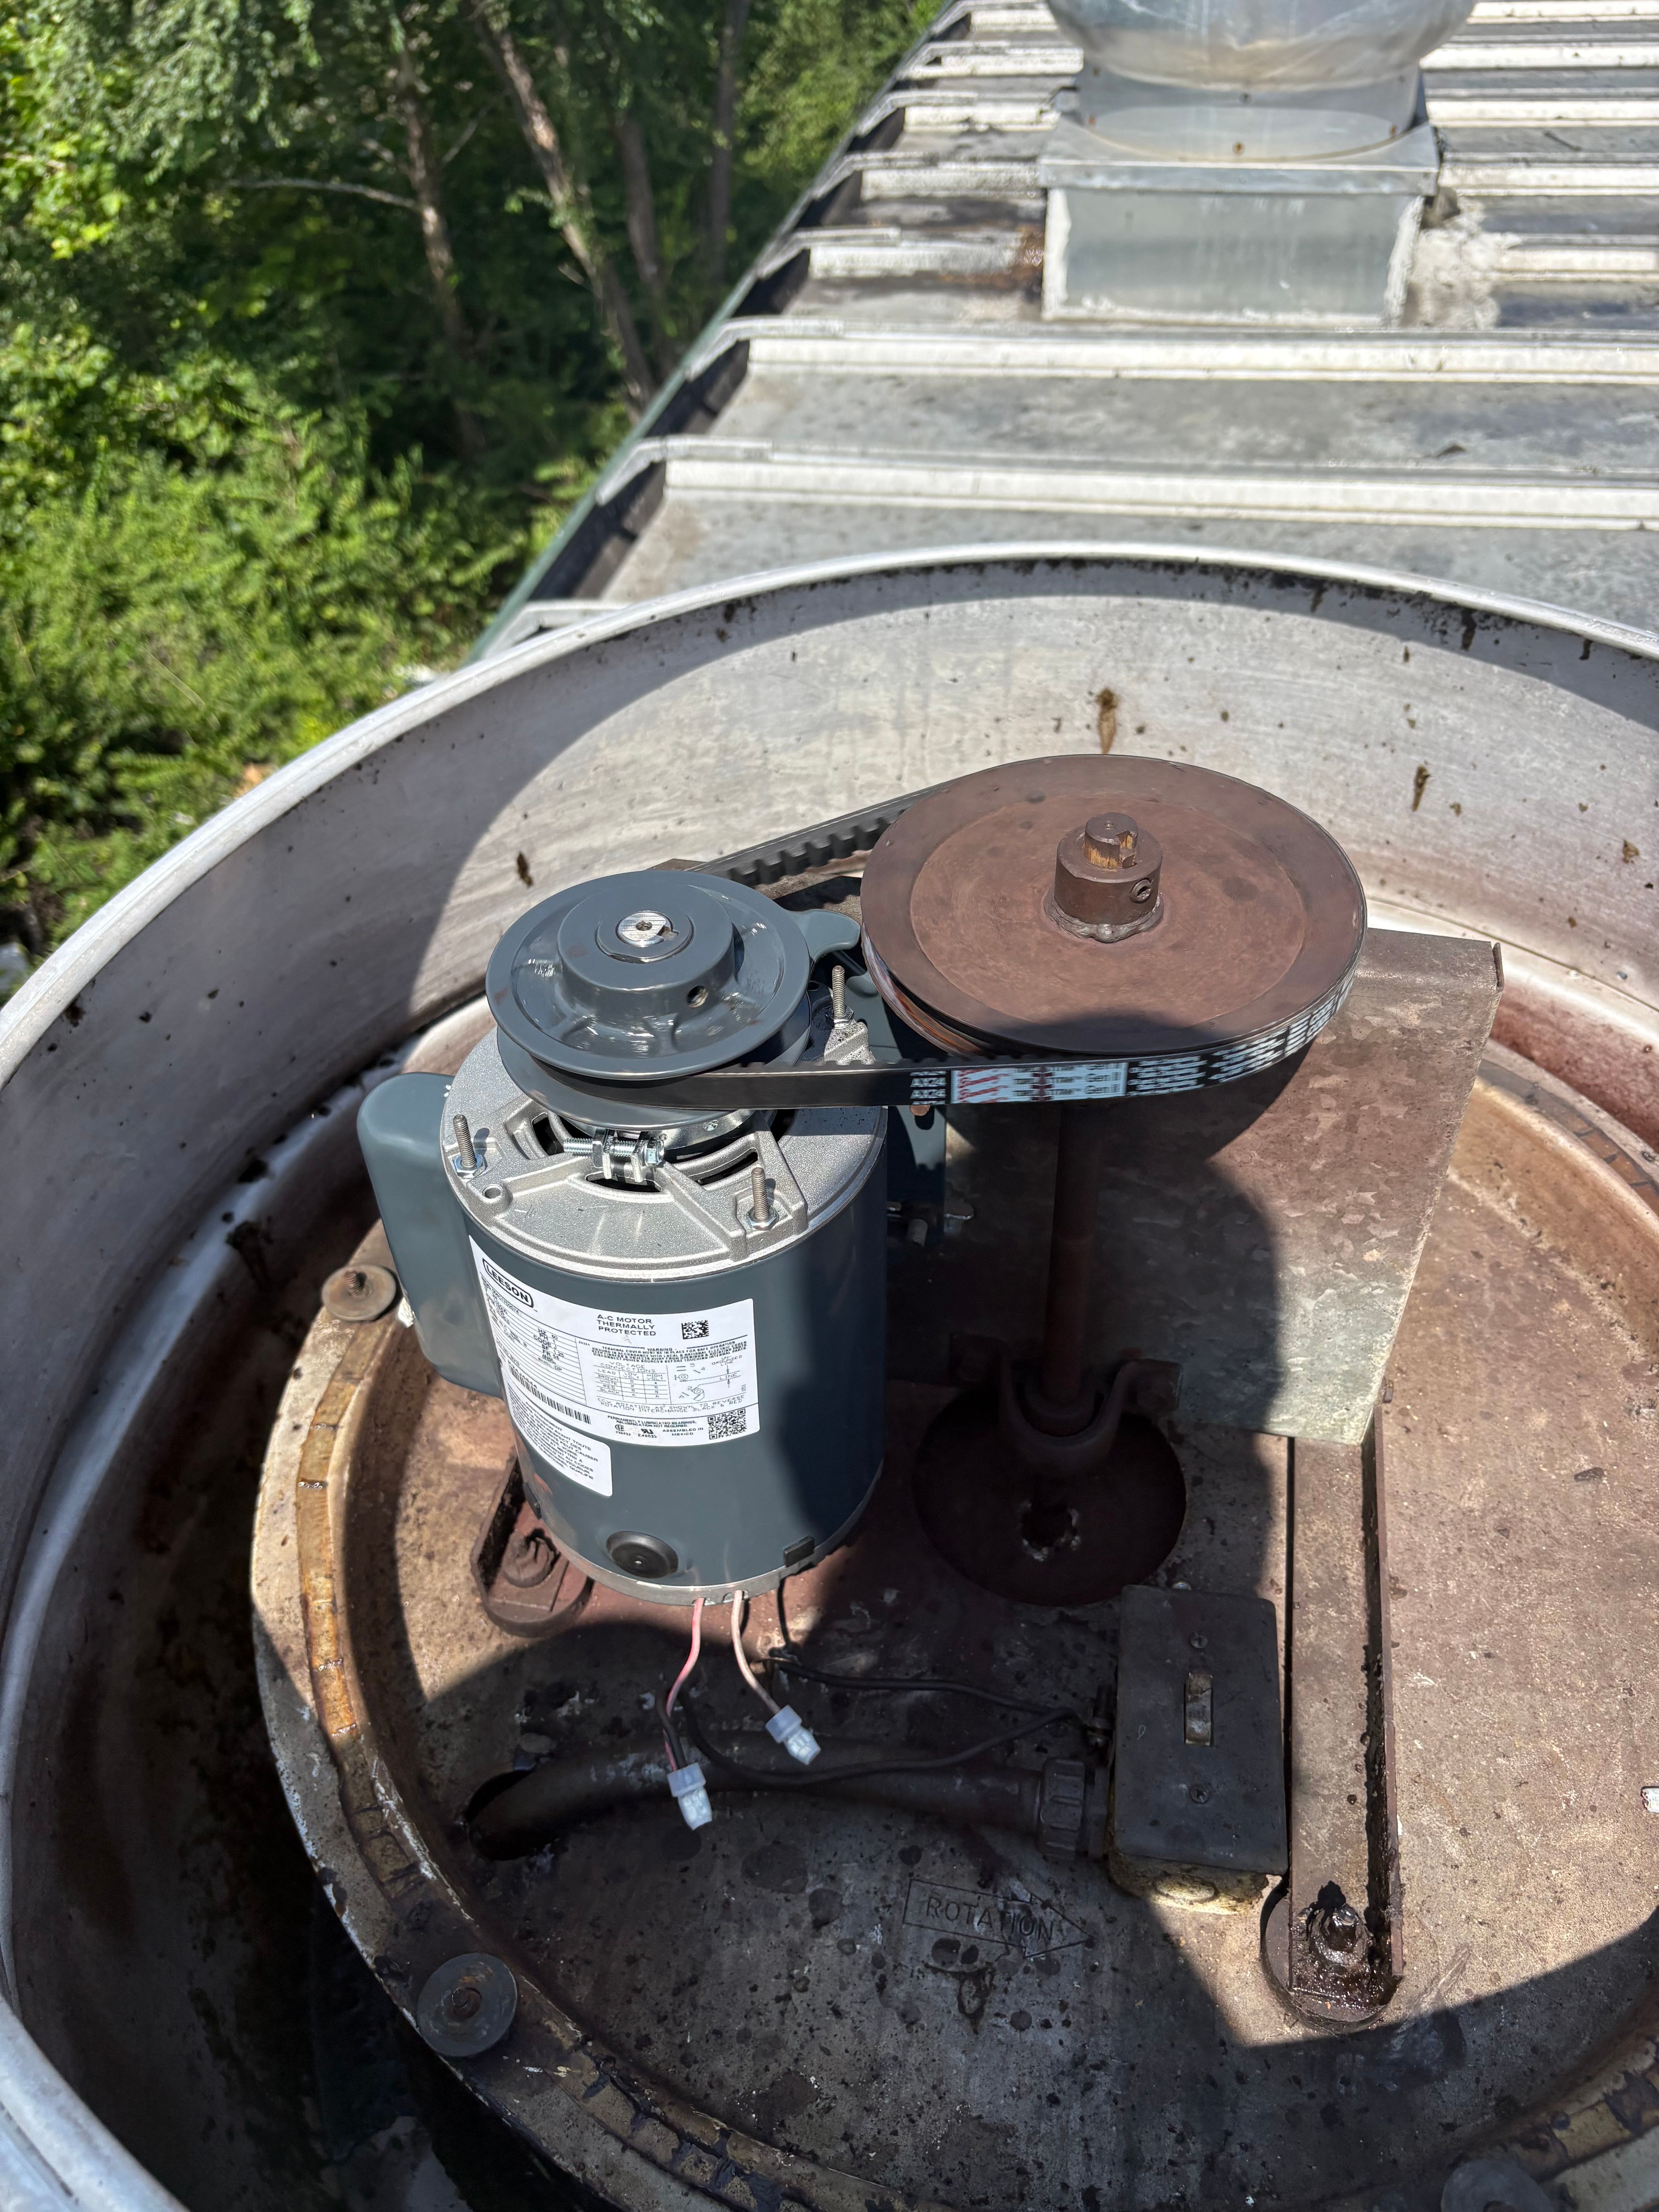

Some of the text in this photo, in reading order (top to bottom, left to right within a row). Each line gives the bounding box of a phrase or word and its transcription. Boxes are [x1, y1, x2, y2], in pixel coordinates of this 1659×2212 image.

[486, 1264, 529, 1303] LEESON
[596, 1319, 655, 1329] THERMALLY
[598, 1326, 656, 1336] PROTECTED
[533, 1335, 551, 1348] CODE
[601, 1363, 656, 1372] CONNECTIONS
[713, 1395, 744, 1405] REVERSE
[572, 1439, 591, 1451] TOUTE
[575, 1449, 598, 1462] CAUSER
[574, 1461, 594, 1472] CODES
[926, 1896, 1053, 1941] ROTATION
